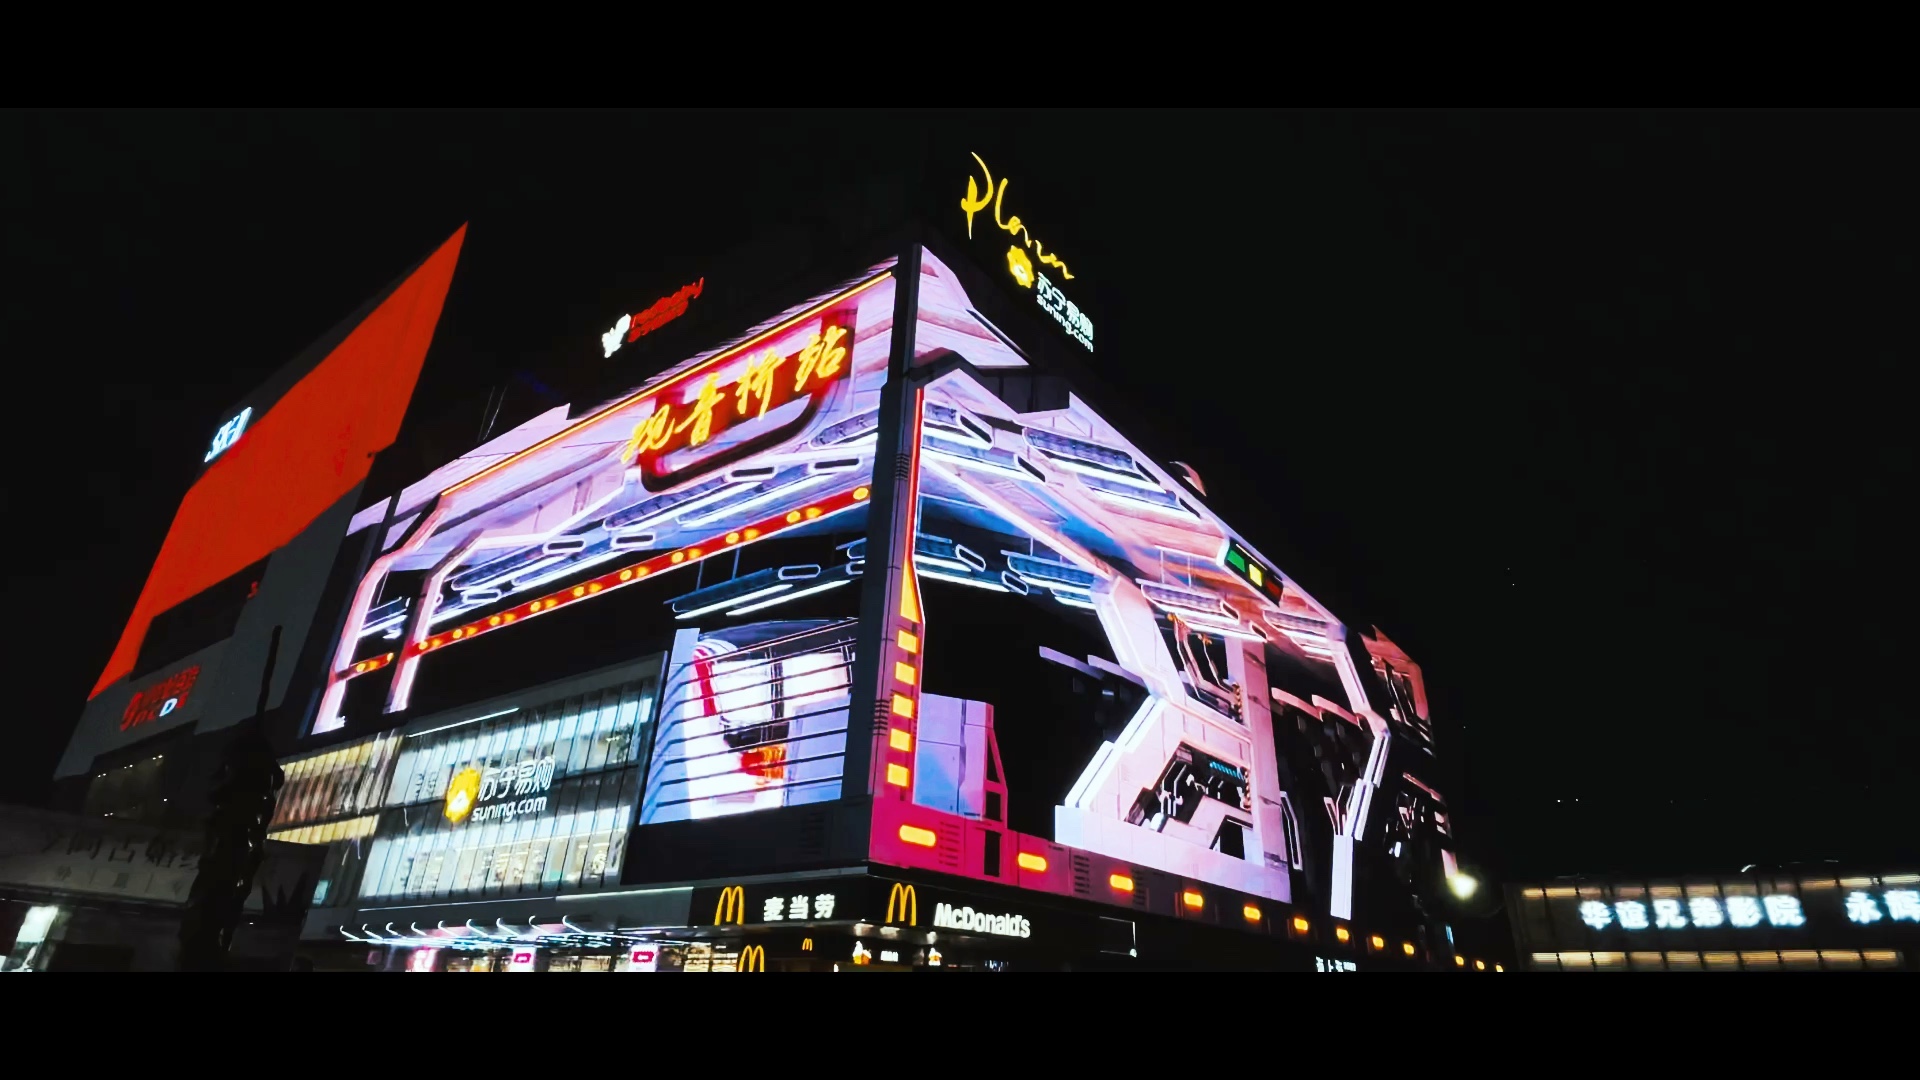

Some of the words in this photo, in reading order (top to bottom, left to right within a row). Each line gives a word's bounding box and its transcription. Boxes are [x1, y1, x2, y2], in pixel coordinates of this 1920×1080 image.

[621, 325, 848, 464] 观音桥站
[471, 796, 547, 823] suning.com
[763, 893, 836, 922] 麦当劳
[933, 901, 1032, 939] McDonald's
[1579, 894, 1807, 931] 华谊兄弟影院
